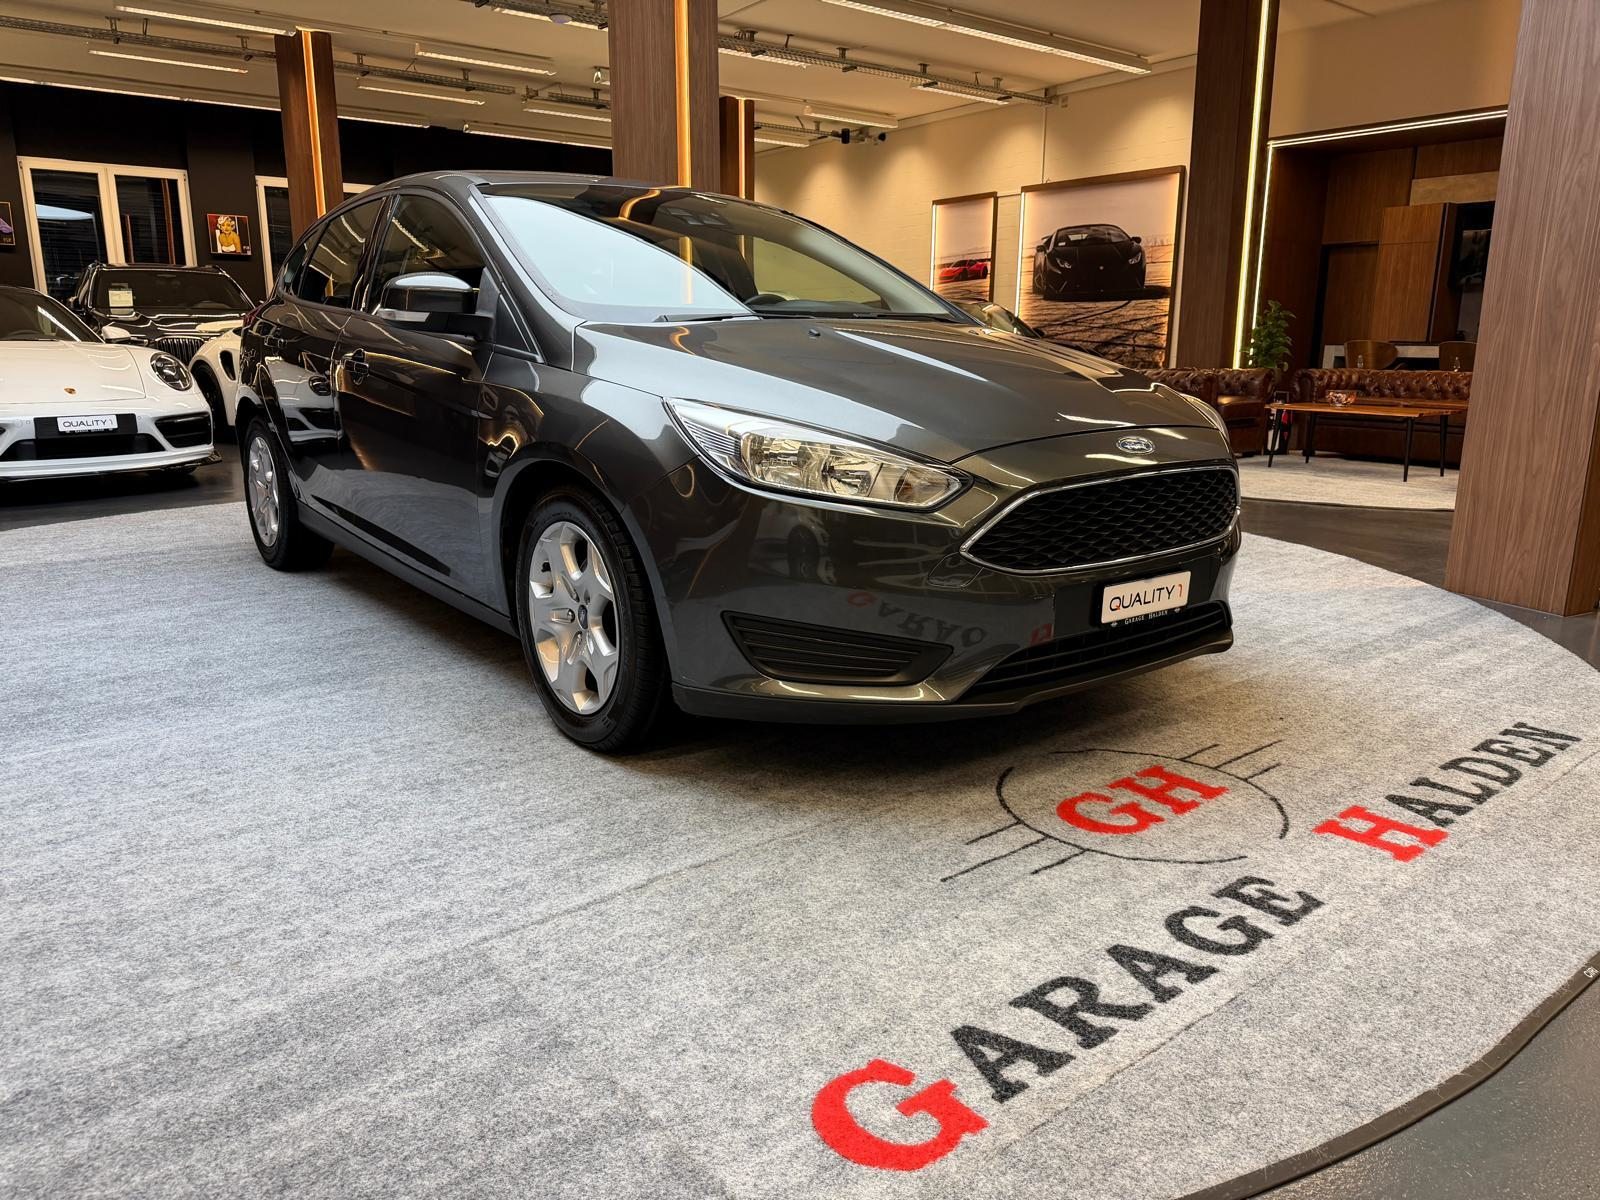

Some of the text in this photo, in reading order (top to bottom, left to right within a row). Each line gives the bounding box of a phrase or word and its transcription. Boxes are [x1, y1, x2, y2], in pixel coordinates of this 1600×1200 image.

[63, 419, 107, 428] QUALITY
[1109, 584, 1176, 612] QUALITY
[1056, 765, 1230, 835] GH
[811, 721, 1582, 1171] GARAGE HALDEN
